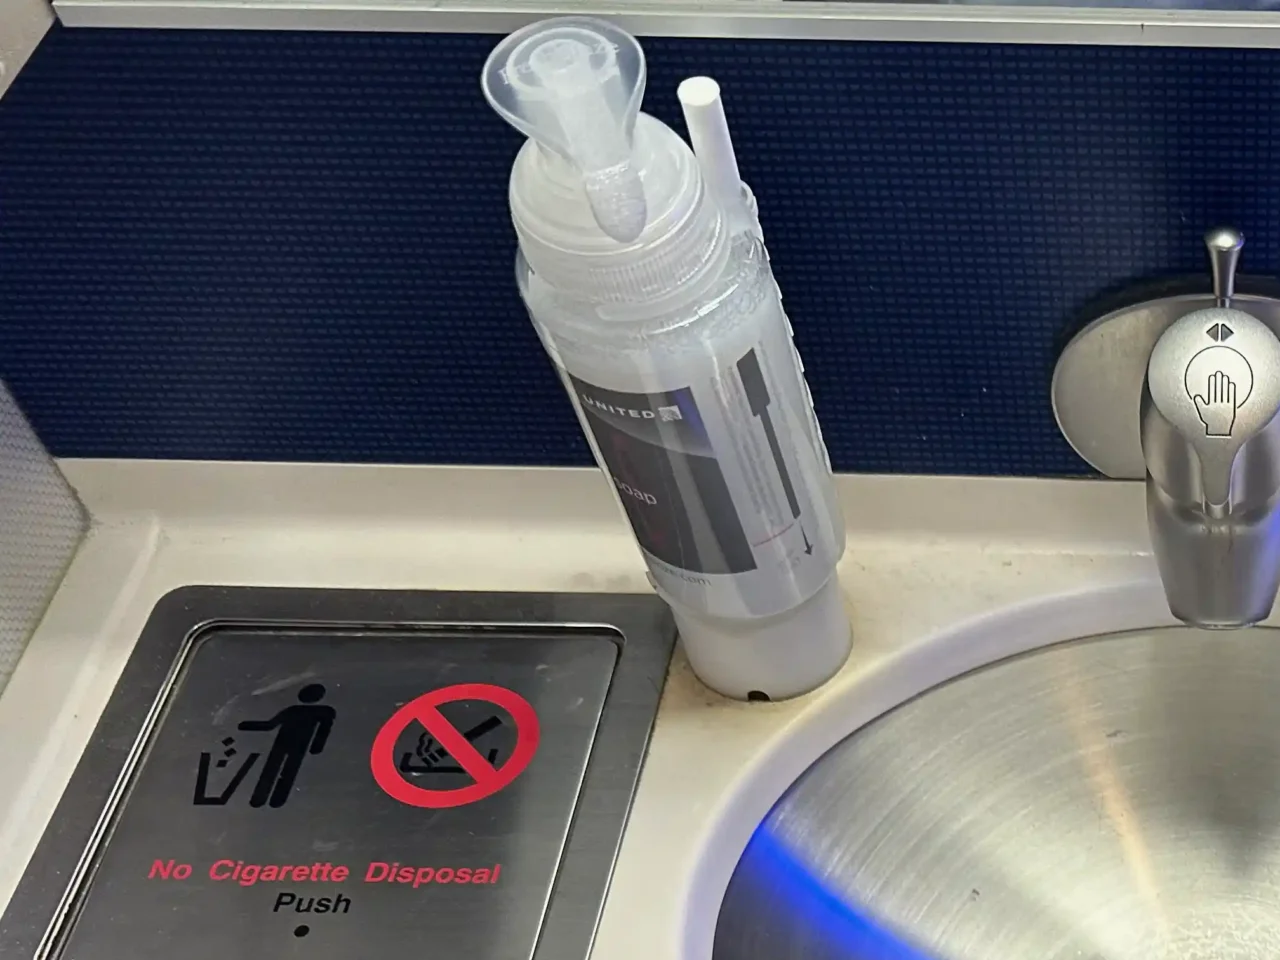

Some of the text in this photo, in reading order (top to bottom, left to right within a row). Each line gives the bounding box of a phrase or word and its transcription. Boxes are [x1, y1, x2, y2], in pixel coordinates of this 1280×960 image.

[582, 393, 656, 419] UNITED
[148, 859, 502, 888] No Cigarette Disposal
[272, 892, 352, 914] Push
